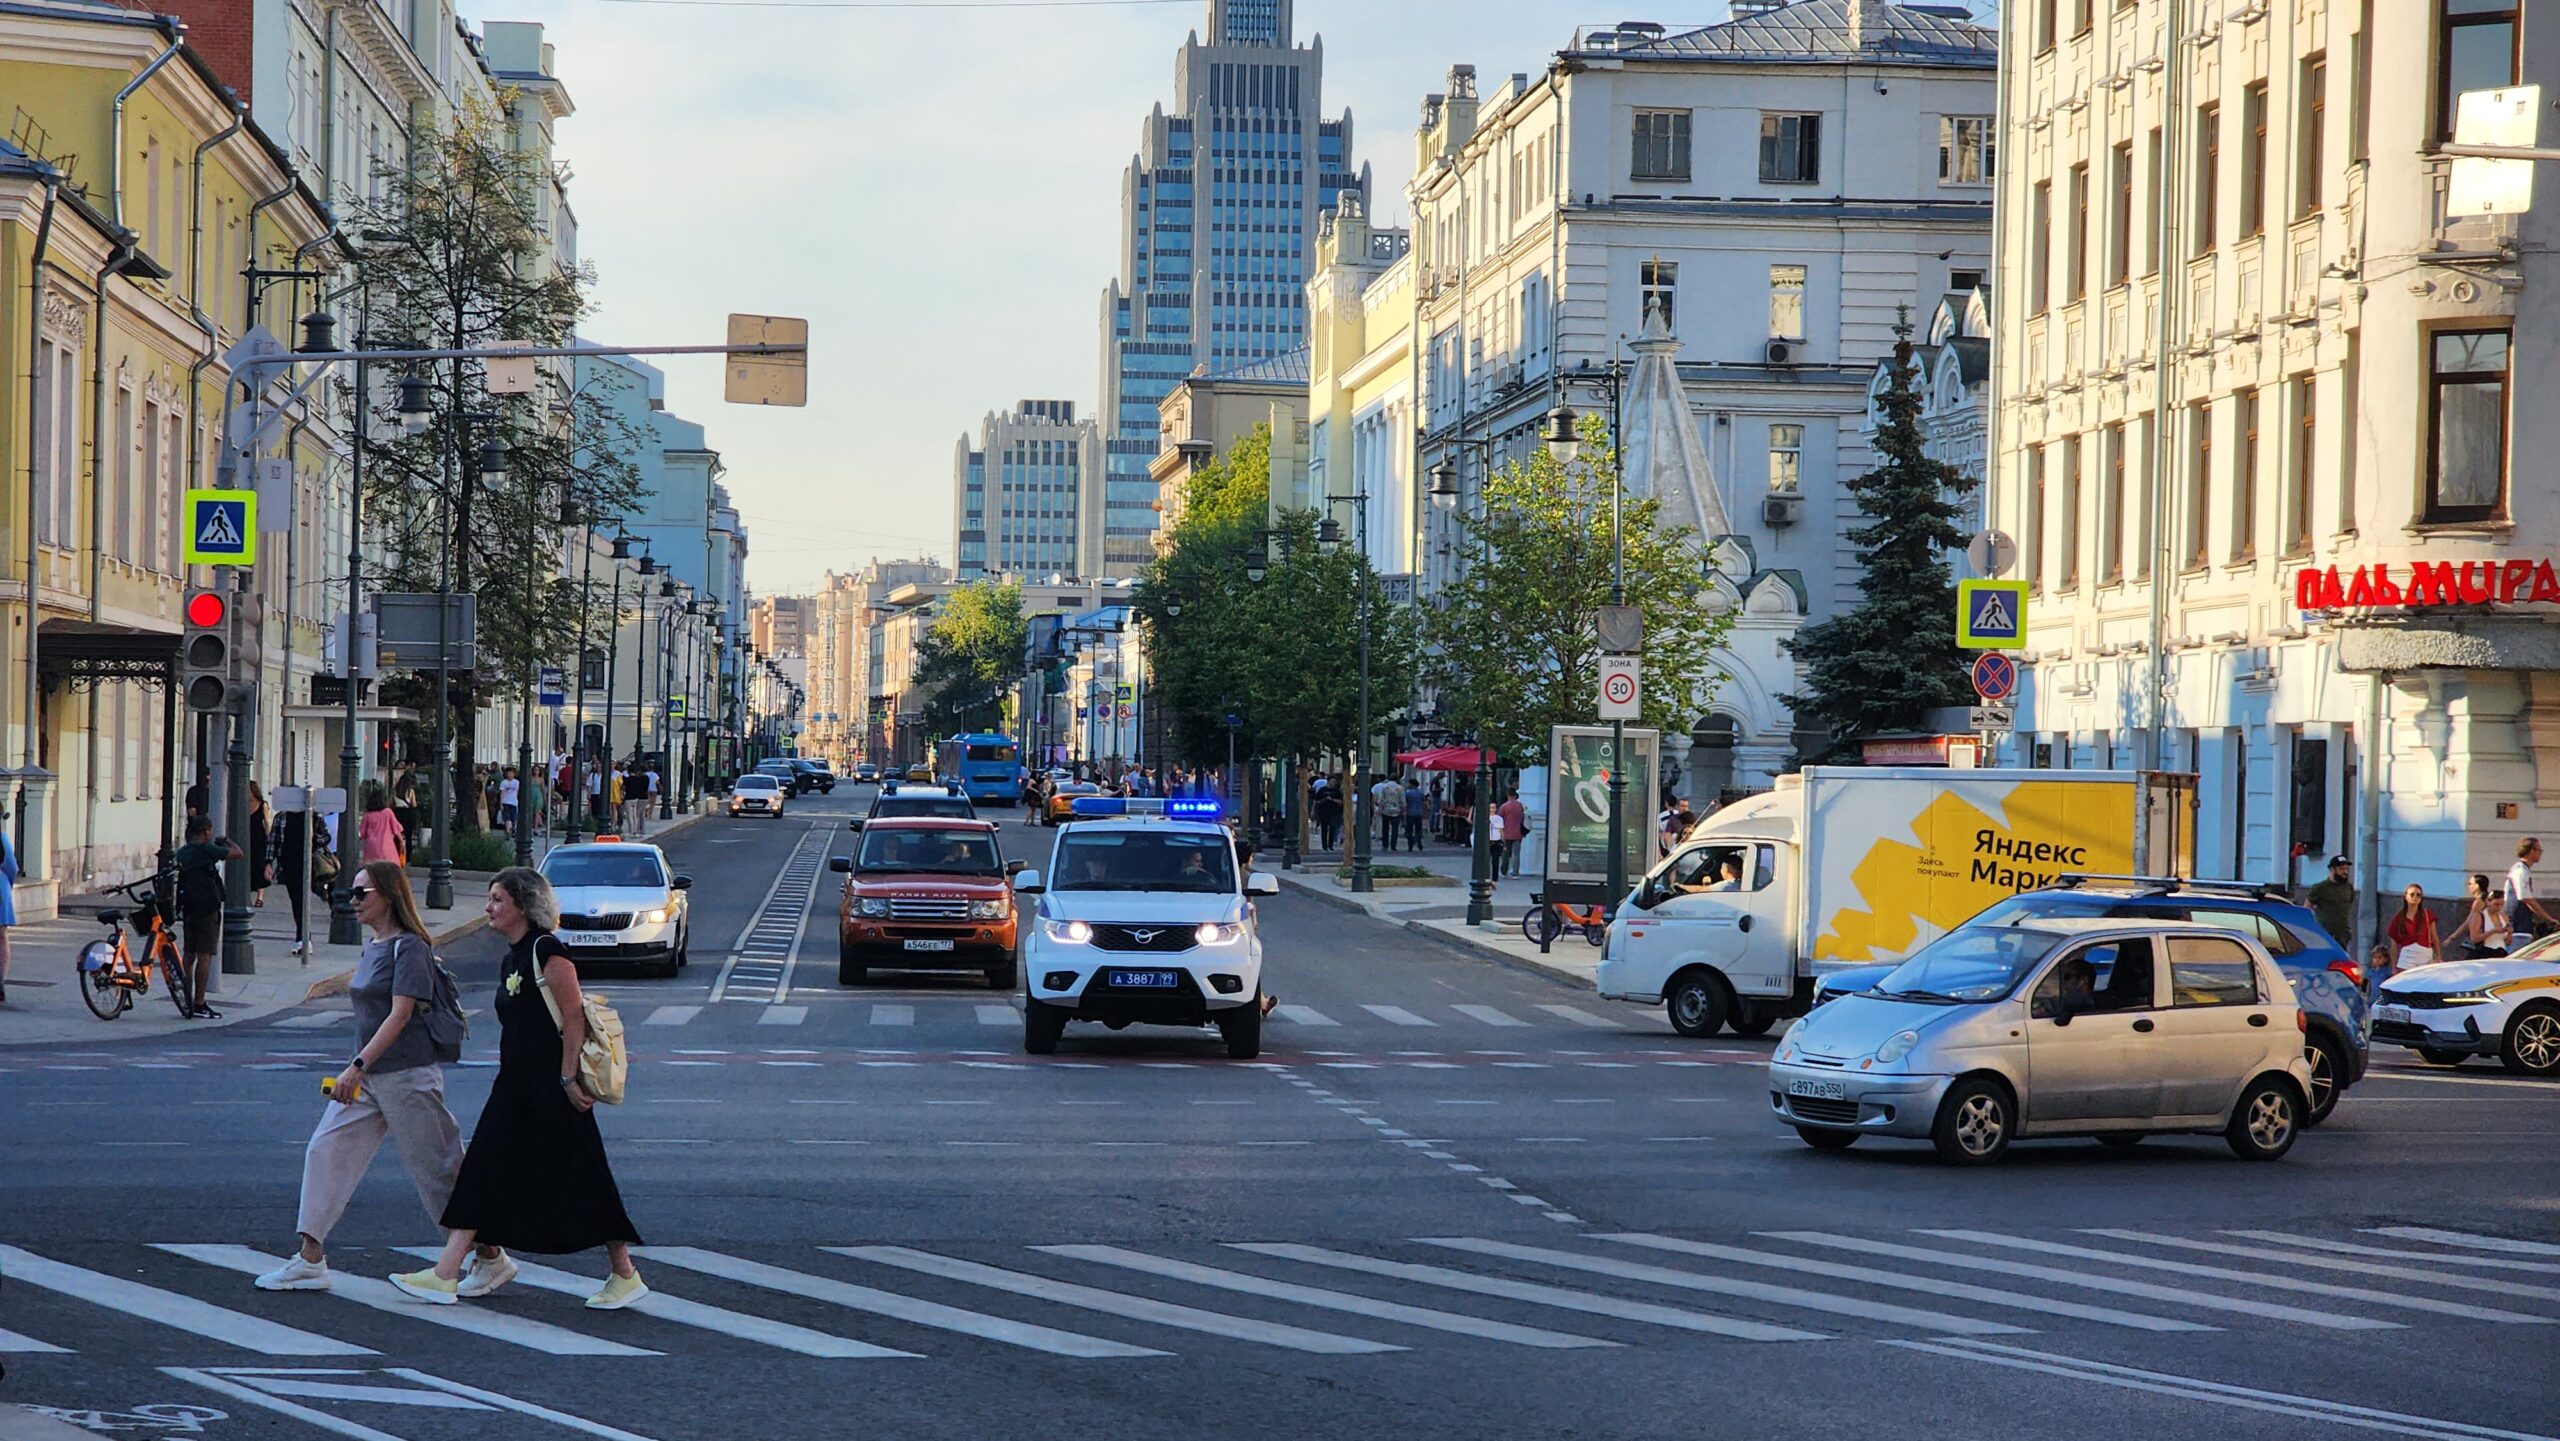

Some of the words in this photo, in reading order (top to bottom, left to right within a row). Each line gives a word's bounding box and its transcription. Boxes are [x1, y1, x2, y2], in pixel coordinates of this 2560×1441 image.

[1608, 660, 1632, 668] ЗОНА
[1611, 683, 1628, 695] 30
[1973, 829, 2087, 866] Яндекс
[1918, 855, 1944, 866] Здесь
[1917, 868, 1960, 878] покупают
[1970, 858, 2061, 894] Марк
[1126, 973, 1155, 985] 3887
[1161, 973, 1173, 984] 99
